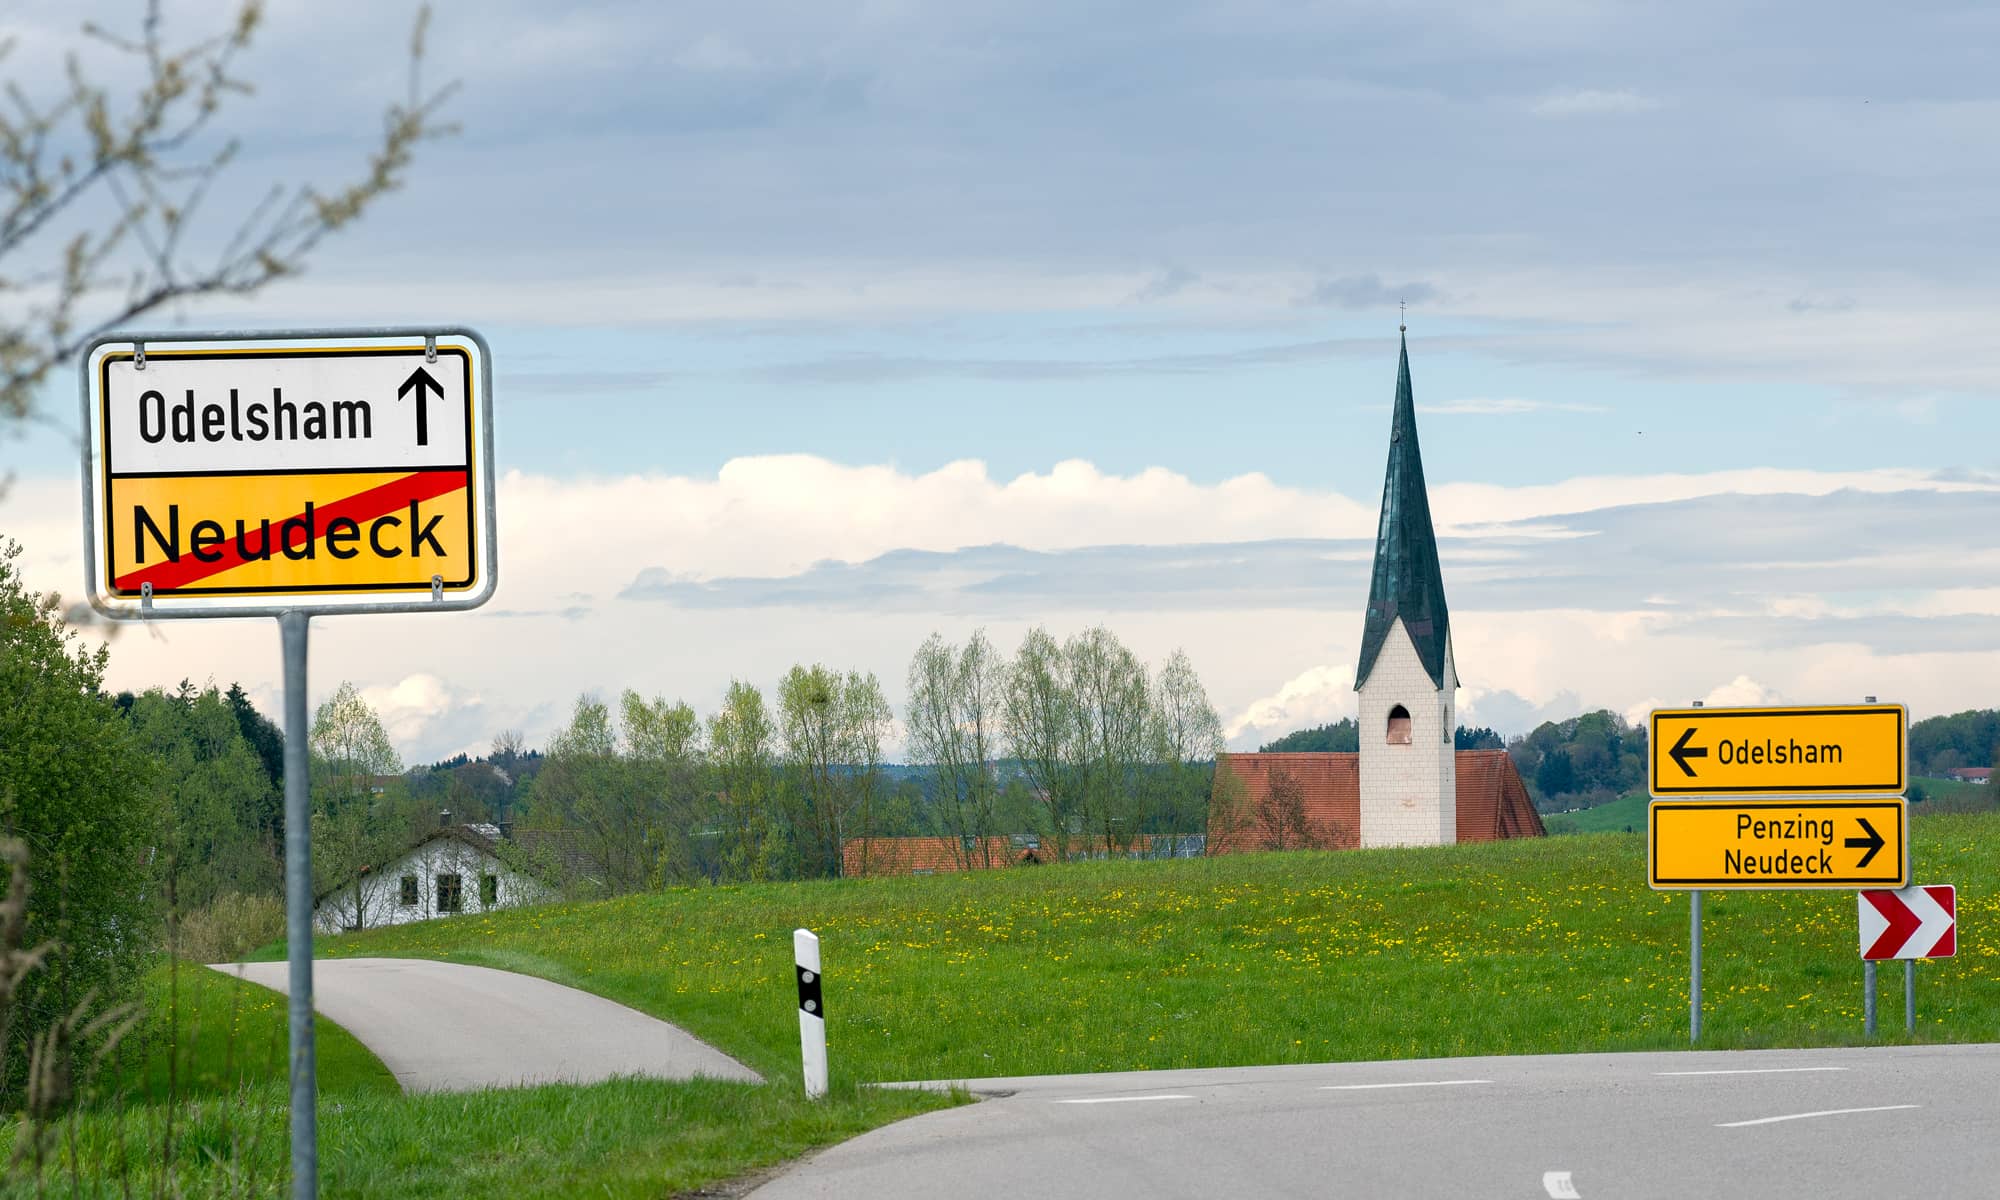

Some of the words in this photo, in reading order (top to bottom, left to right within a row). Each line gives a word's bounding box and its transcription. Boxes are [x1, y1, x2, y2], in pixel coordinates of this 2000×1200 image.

[138, 388, 372, 444] Odelsham
[133, 499, 447, 564] Neudeck
[1718, 738, 1842, 765] Odelsham
[1736, 813, 1833, 845] Penzing
[1724, 848, 1833, 874] Neudeck
